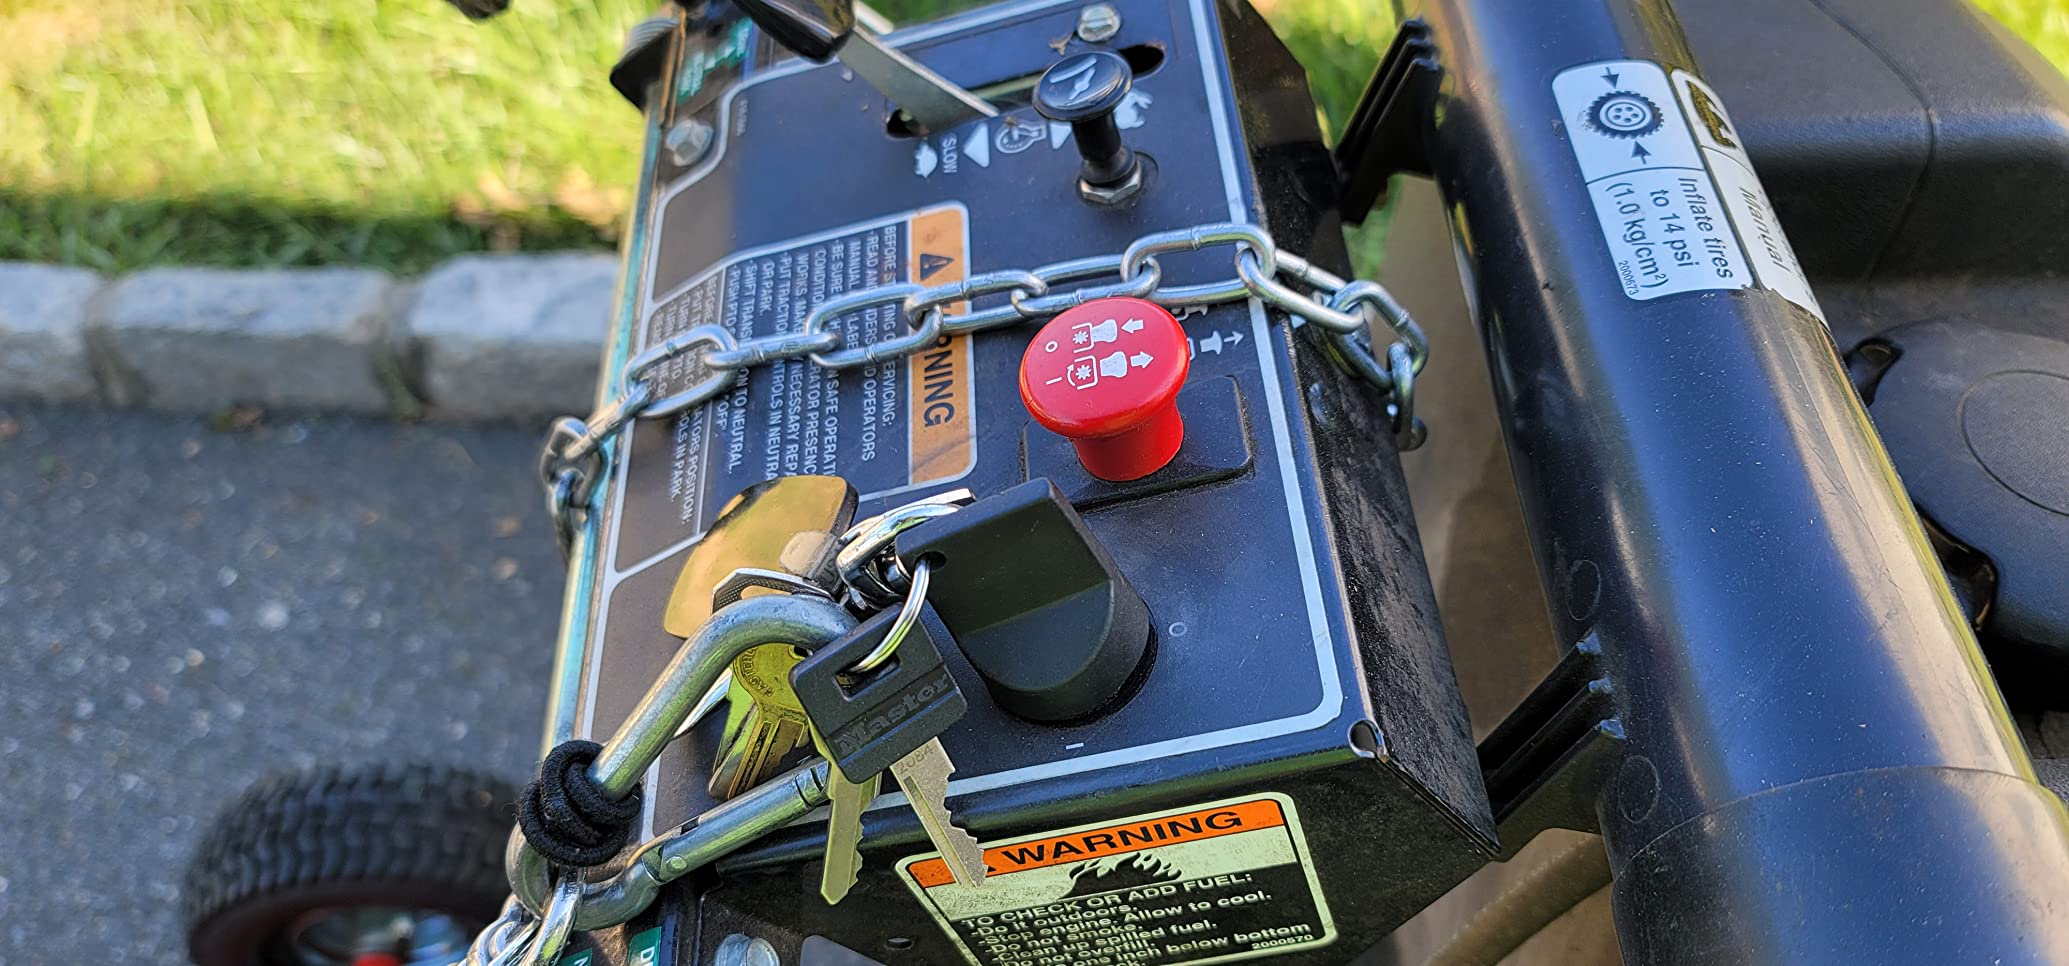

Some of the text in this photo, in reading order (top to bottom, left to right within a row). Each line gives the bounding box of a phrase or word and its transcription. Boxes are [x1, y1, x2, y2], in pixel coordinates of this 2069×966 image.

[943, 137, 957, 173] SLOW
[1604, 182, 1640, 215] (1.0
[884, 225, 897, 270] BEFORE
[1650, 189, 1700, 268] to 14 psi
[1678, 177, 1733, 280] Inflate tires
[1739, 187, 1790, 273] Manual
[830, 263, 843, 294] SURE
[848, 239, 862, 290] MANUAL
[1618, 260, 1639, 296] 2000673
[759, 261, 775, 317] OR PARK.
[883, 272, 897, 330] STTING
[726, 302, 738, 327] PTO
[734, 388, 748, 407] TO
[787, 364, 803, 440] NECESSARY
[826, 379, 840, 415] SAFE
[882, 356, 897, 427] ERVICING:
[727, 408, 746, 474] NEUTRAL.
[768, 411, 782, 425] IN
[862, 380, 878, 461] OPERATORS
[674, 444, 686, 459] IN
[765, 427, 781, 481] NEUTRA
[803, 411, 819, 475] PRESENC
[671, 459, 685, 503] PARK.
[681, 455, 698, 526] POSITION:
[834, 674, 949, 755] Master
[1000, 810, 1243, 866] WARNING
[961, 873, 1252, 929] TO CHECK OR ADD FUEL:
[971, 904, 1138, 938] -Do it outdoors.
[978, 890, 1272, 946] -Stop engine. Allow to cool.
[985, 923, 1143, 955] -Do not smoke.
[1039, 951, 1073, 965] not
[1078, 939, 1155, 958] overfill.
[1062, 940, 1090, 954] up
[1095, 926, 1166, 947] spilled
[1169, 919, 1217, 936] fuel.
[1116, 947, 1161, 962] inch
[1166, 935, 1229, 955] below
[1234, 923, 1312, 944] bottom
[1251, 933, 1314, 950] 2000570
